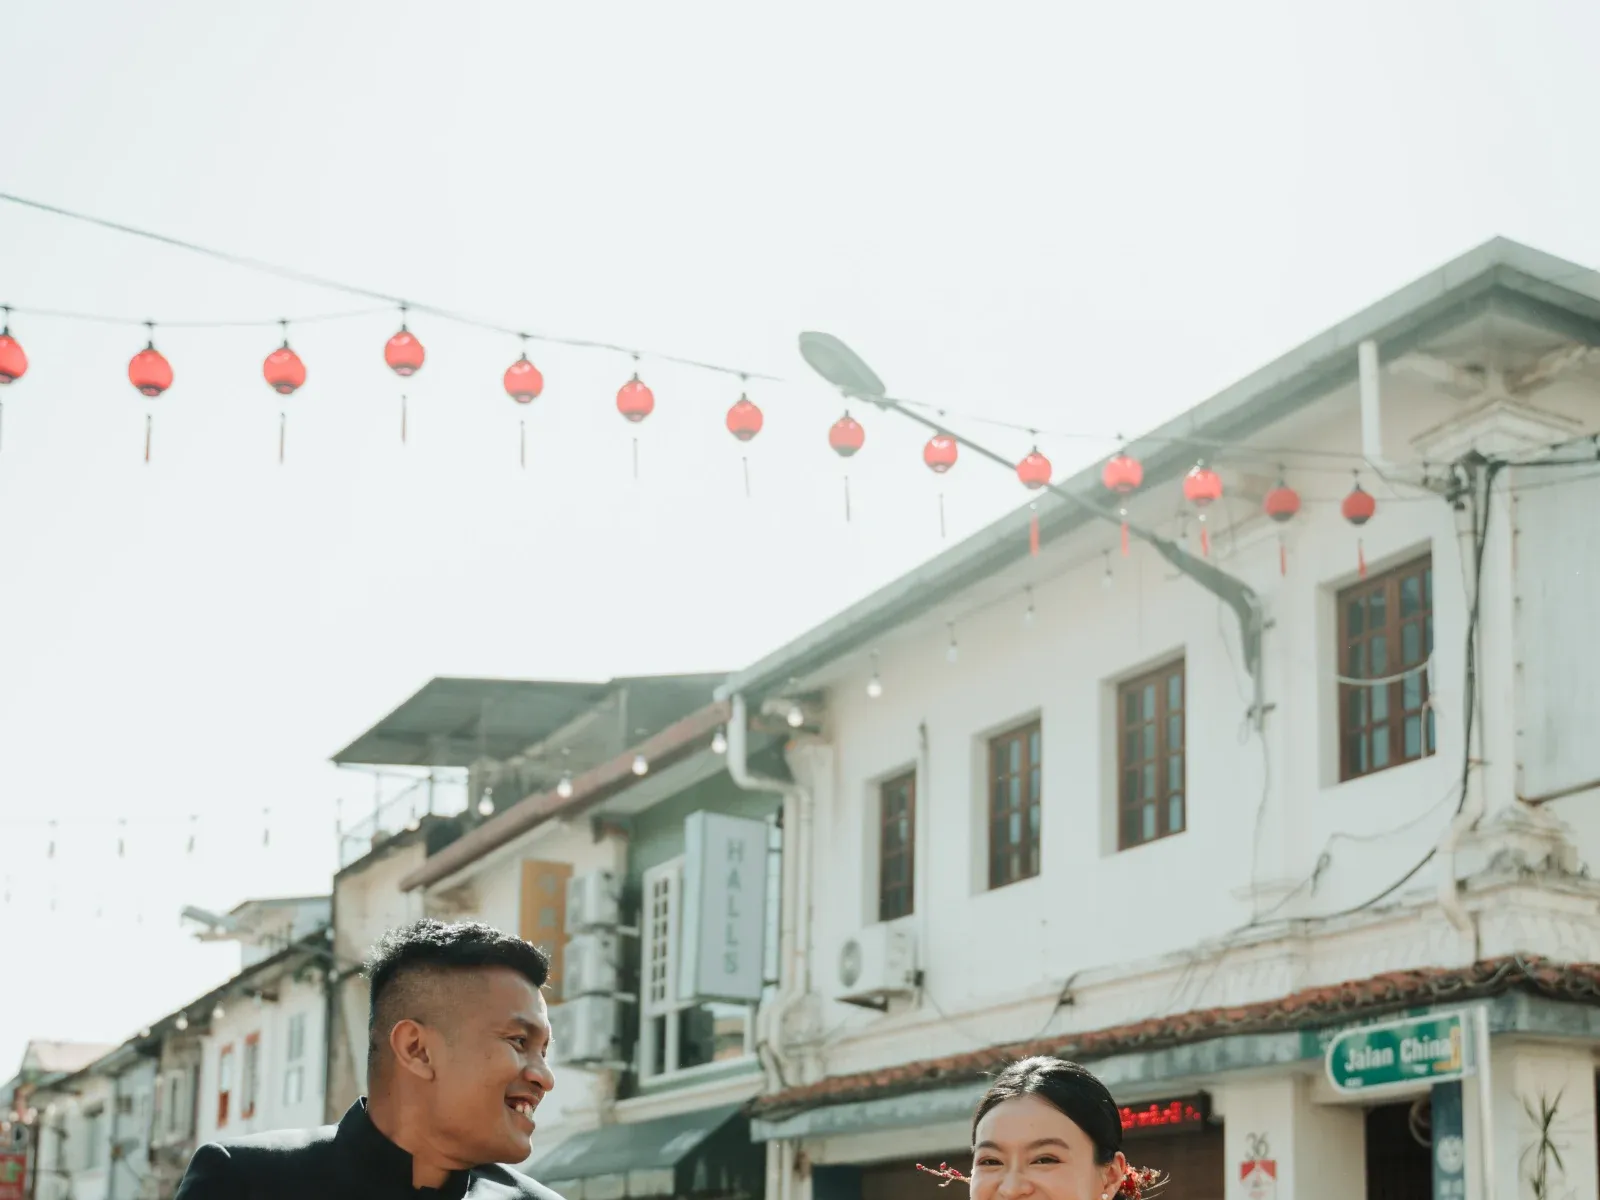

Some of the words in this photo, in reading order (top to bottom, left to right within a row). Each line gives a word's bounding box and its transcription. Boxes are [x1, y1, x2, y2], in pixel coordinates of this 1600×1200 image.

[724, 838, 744, 975] HALLS
[1344, 1045, 1395, 1073] Jalan
[1400, 1034, 1453, 1064] China
[1245, 1131, 1270, 1161] 36
